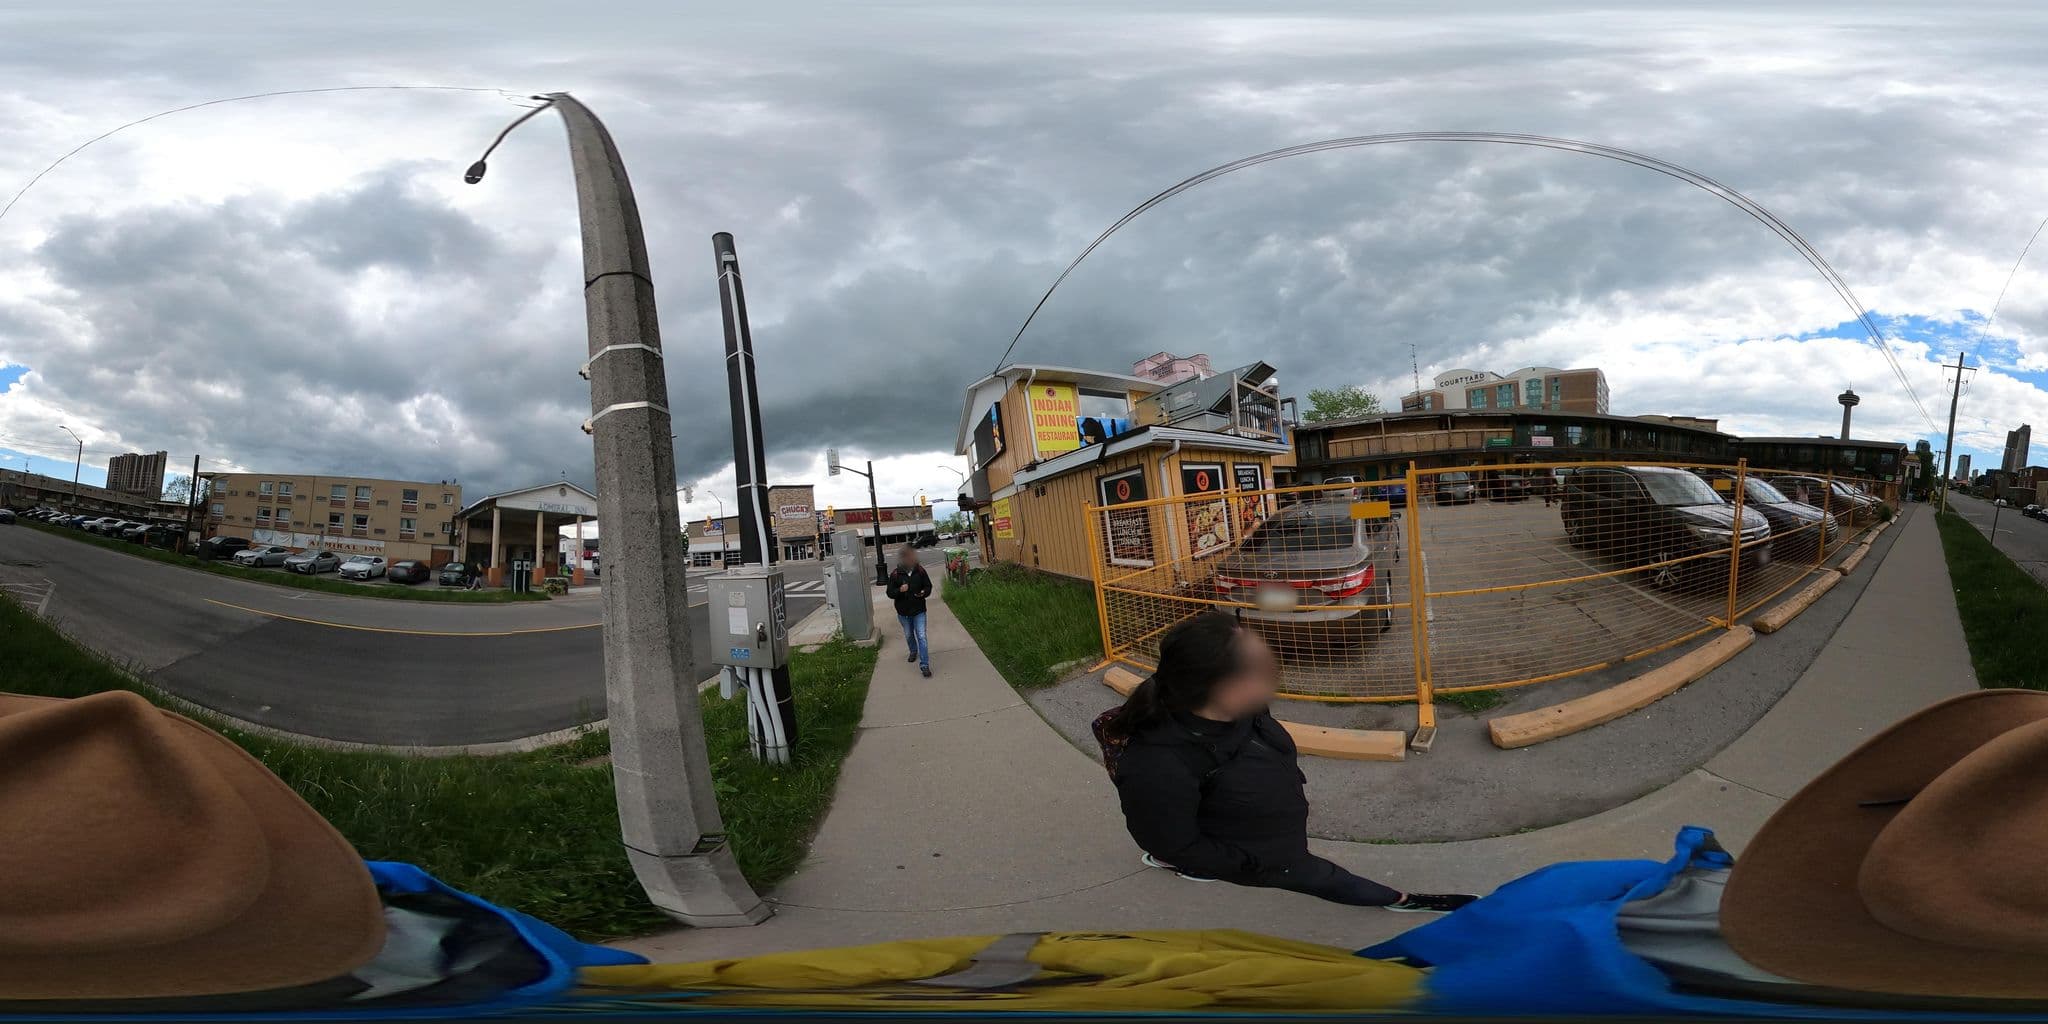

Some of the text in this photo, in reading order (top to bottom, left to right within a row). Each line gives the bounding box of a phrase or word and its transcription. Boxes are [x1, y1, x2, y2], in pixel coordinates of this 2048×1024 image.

[1439, 373, 1485, 387] COURTYARD
[1033, 399, 1072, 411] INDIAN
[1036, 414, 1075, 428] DINING
[1037, 431, 1078, 441] RESTAURANT
[844, 510, 894, 524] ROADHUSE
[364, 545, 382, 553] INN
